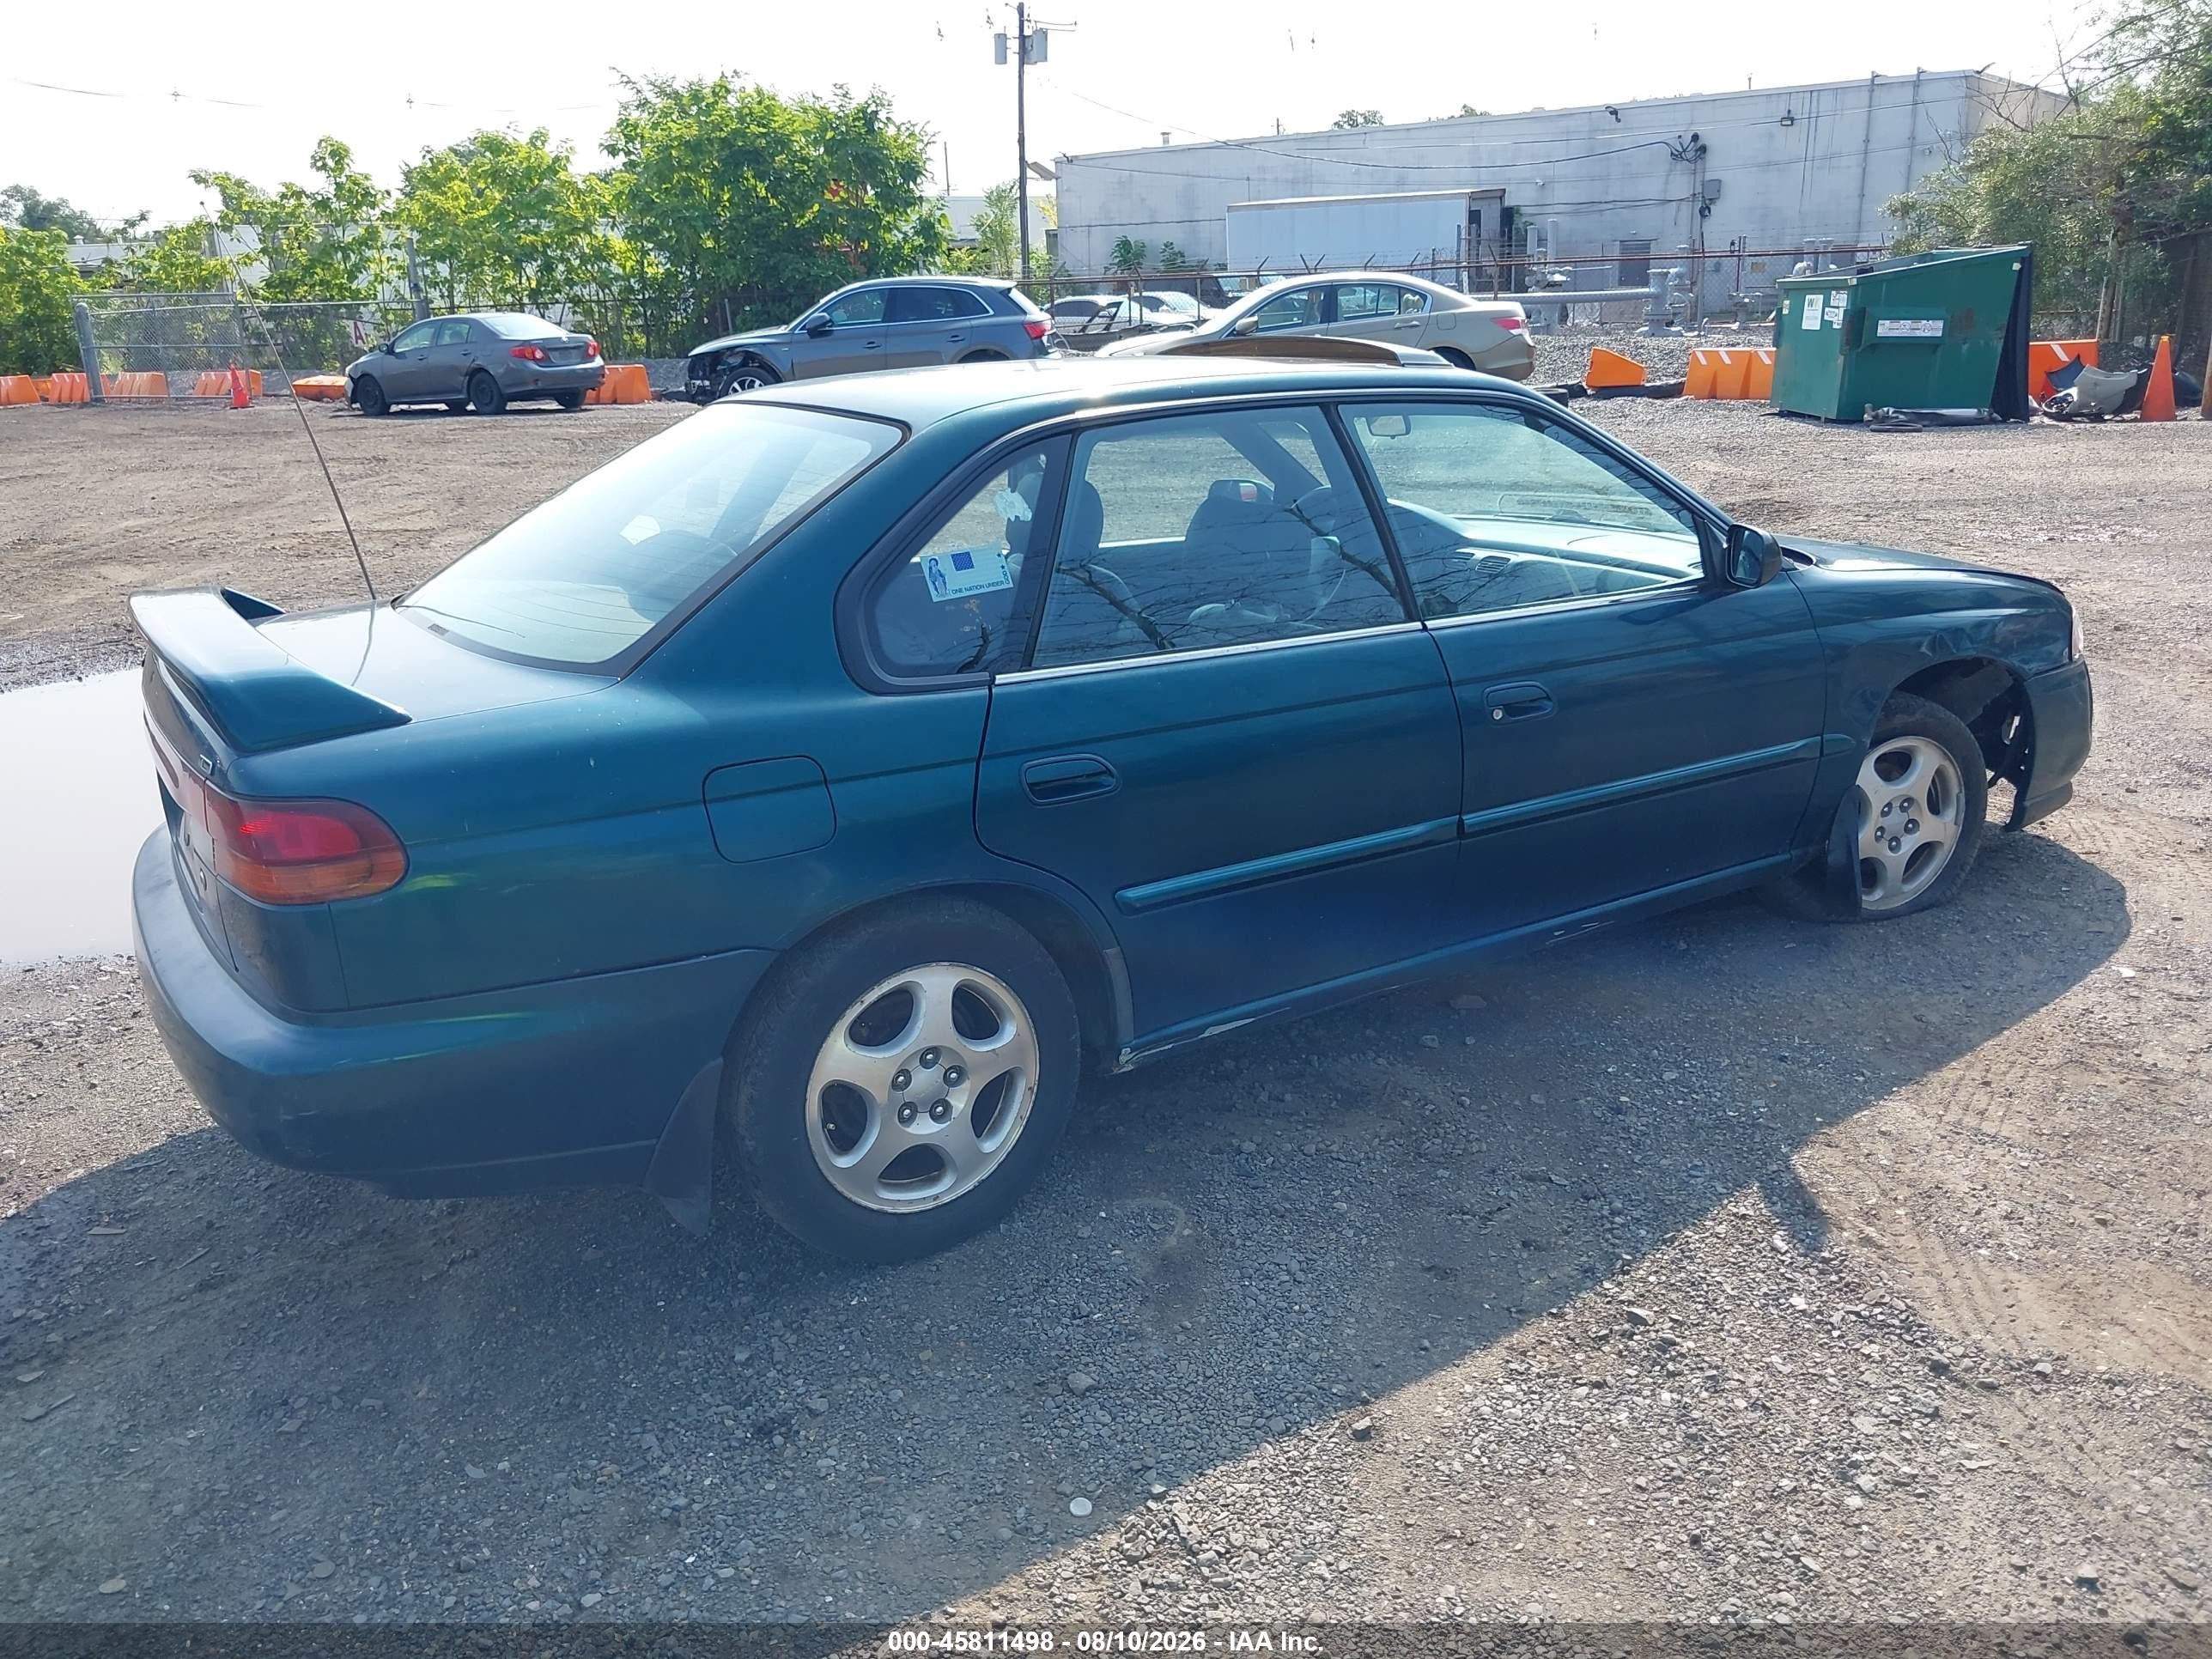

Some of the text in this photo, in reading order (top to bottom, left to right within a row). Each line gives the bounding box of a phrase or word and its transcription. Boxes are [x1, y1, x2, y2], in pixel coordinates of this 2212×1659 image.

[353, 321, 367, 345] A
[964, 584, 985, 592] NATION
[985, 580, 1005, 588] UNDER
[1002, 570, 1011, 585] GOD
